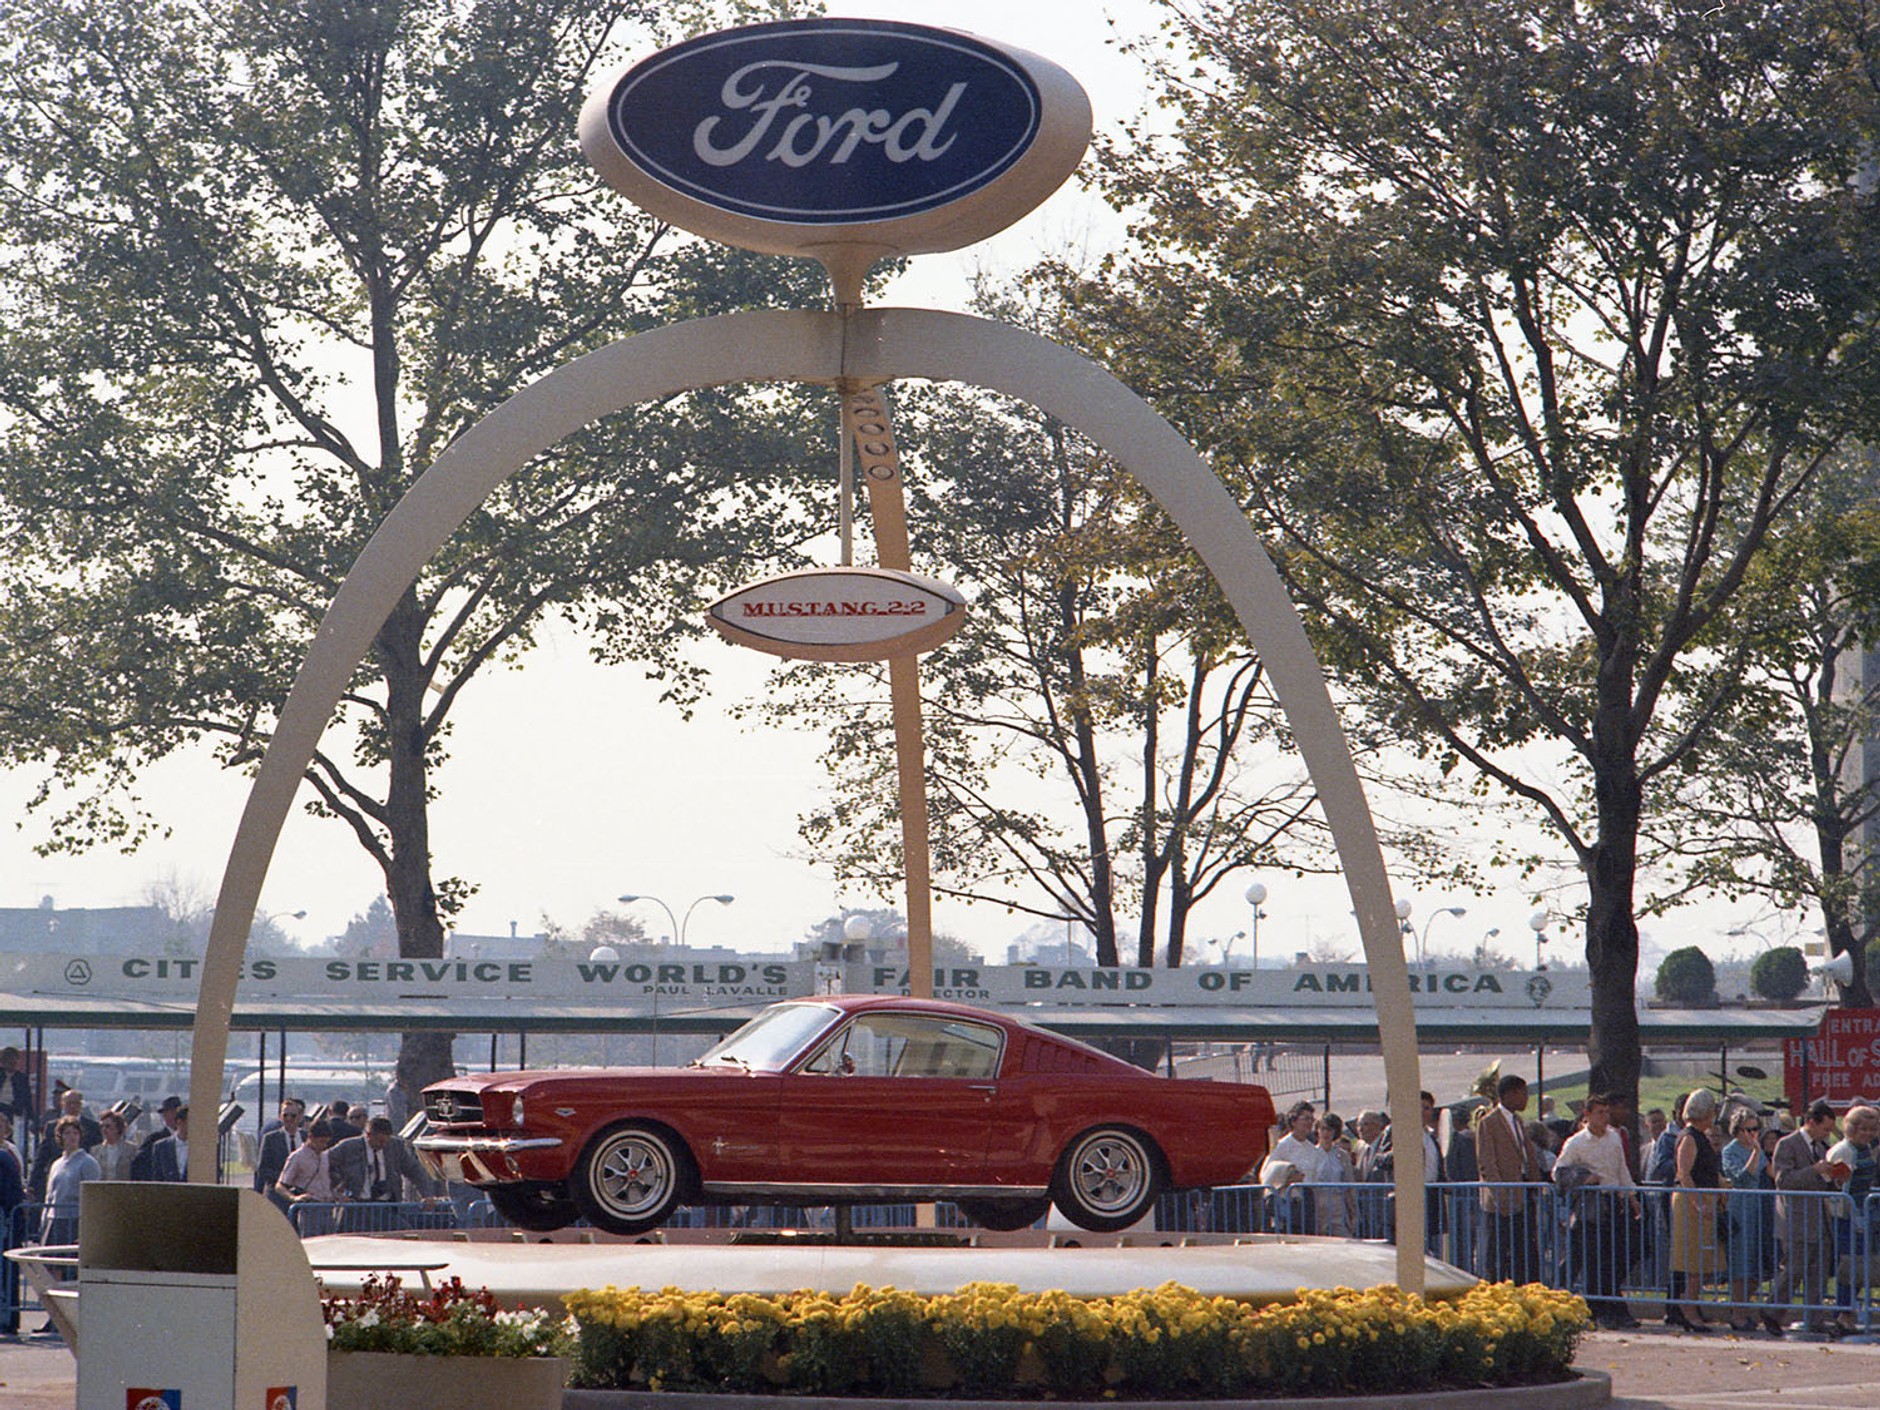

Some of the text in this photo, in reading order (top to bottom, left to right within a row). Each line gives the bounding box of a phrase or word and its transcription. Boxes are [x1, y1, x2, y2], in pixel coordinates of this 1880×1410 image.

[693, 60, 967, 167] Ford
[743, 602, 878, 616] MUSTANG
[122, 959, 277, 980] CITS
[326, 961, 533, 982] SERVICE
[577, 963, 788, 984] WORLD'S
[1024, 970, 1152, 990] BAND
[1199, 972, 1252, 991] OF
[1293, 973, 1504, 993] AMICA
[643, 985, 990, 999] PAUL LAVALLE DECTOR
[1789, 1039, 1845, 1067] HALL
[1848, 1047, 1868, 1067] OF
[1812, 1072, 1850, 1088] FREE
